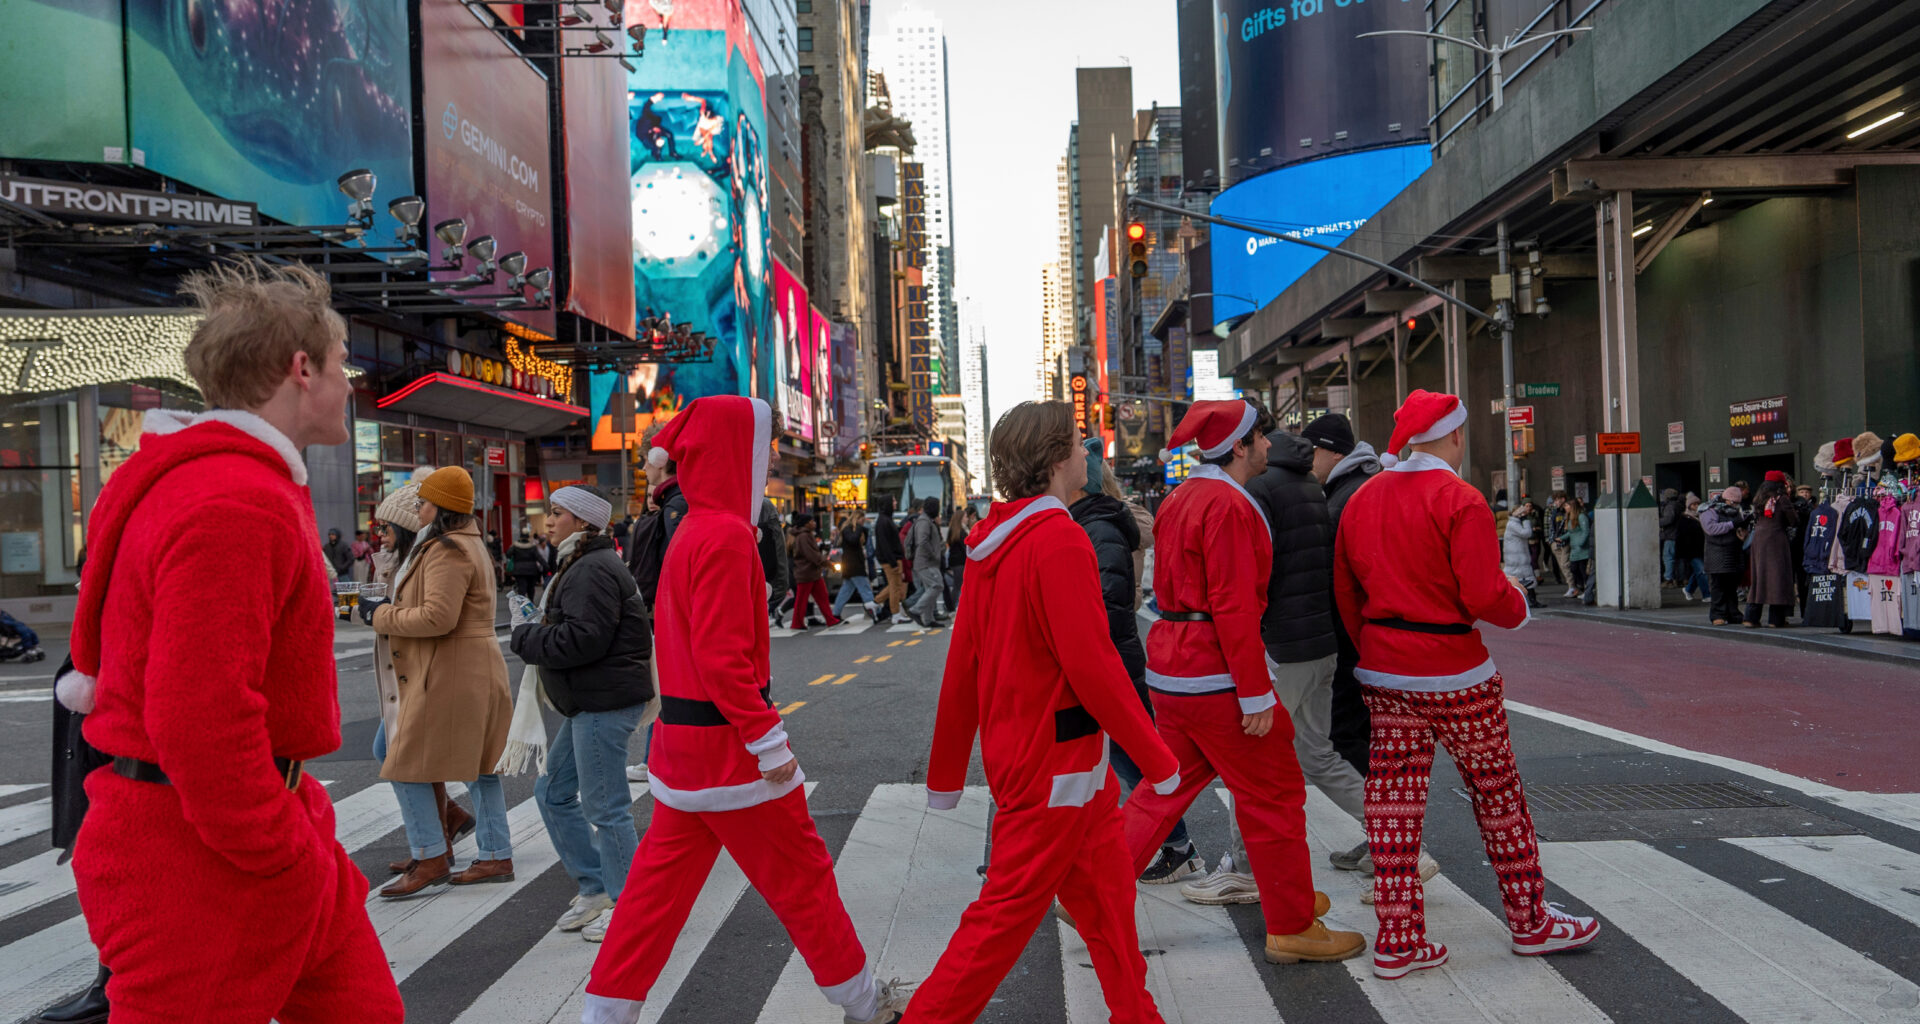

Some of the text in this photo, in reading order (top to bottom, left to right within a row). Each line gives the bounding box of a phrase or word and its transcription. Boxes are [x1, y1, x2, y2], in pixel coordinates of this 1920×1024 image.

[1241, 8, 1286, 42] Gifts
[461, 119, 538, 193] GEMINI.COM
[515, 200, 545, 227] CRYPTO
[906, 164, 925, 266] MADAME
[1259, 236, 1278, 248] MAKE
[1279, 230, 1302, 242] ORE
[1303, 226, 1316, 238] OF
[1316, 220, 1352, 235] WHAT'S
[912, 287, 929, 425] TUSSAUDS
[1527, 385, 1559, 397] Broadway
[1730, 405, 1743, 414] Times
[1768, 399, 1783, 408] Street
[1811, 526, 1828, 537] NY
[1816, 594, 1832, 602] FUCK
[1880, 591, 1895, 601] NY
